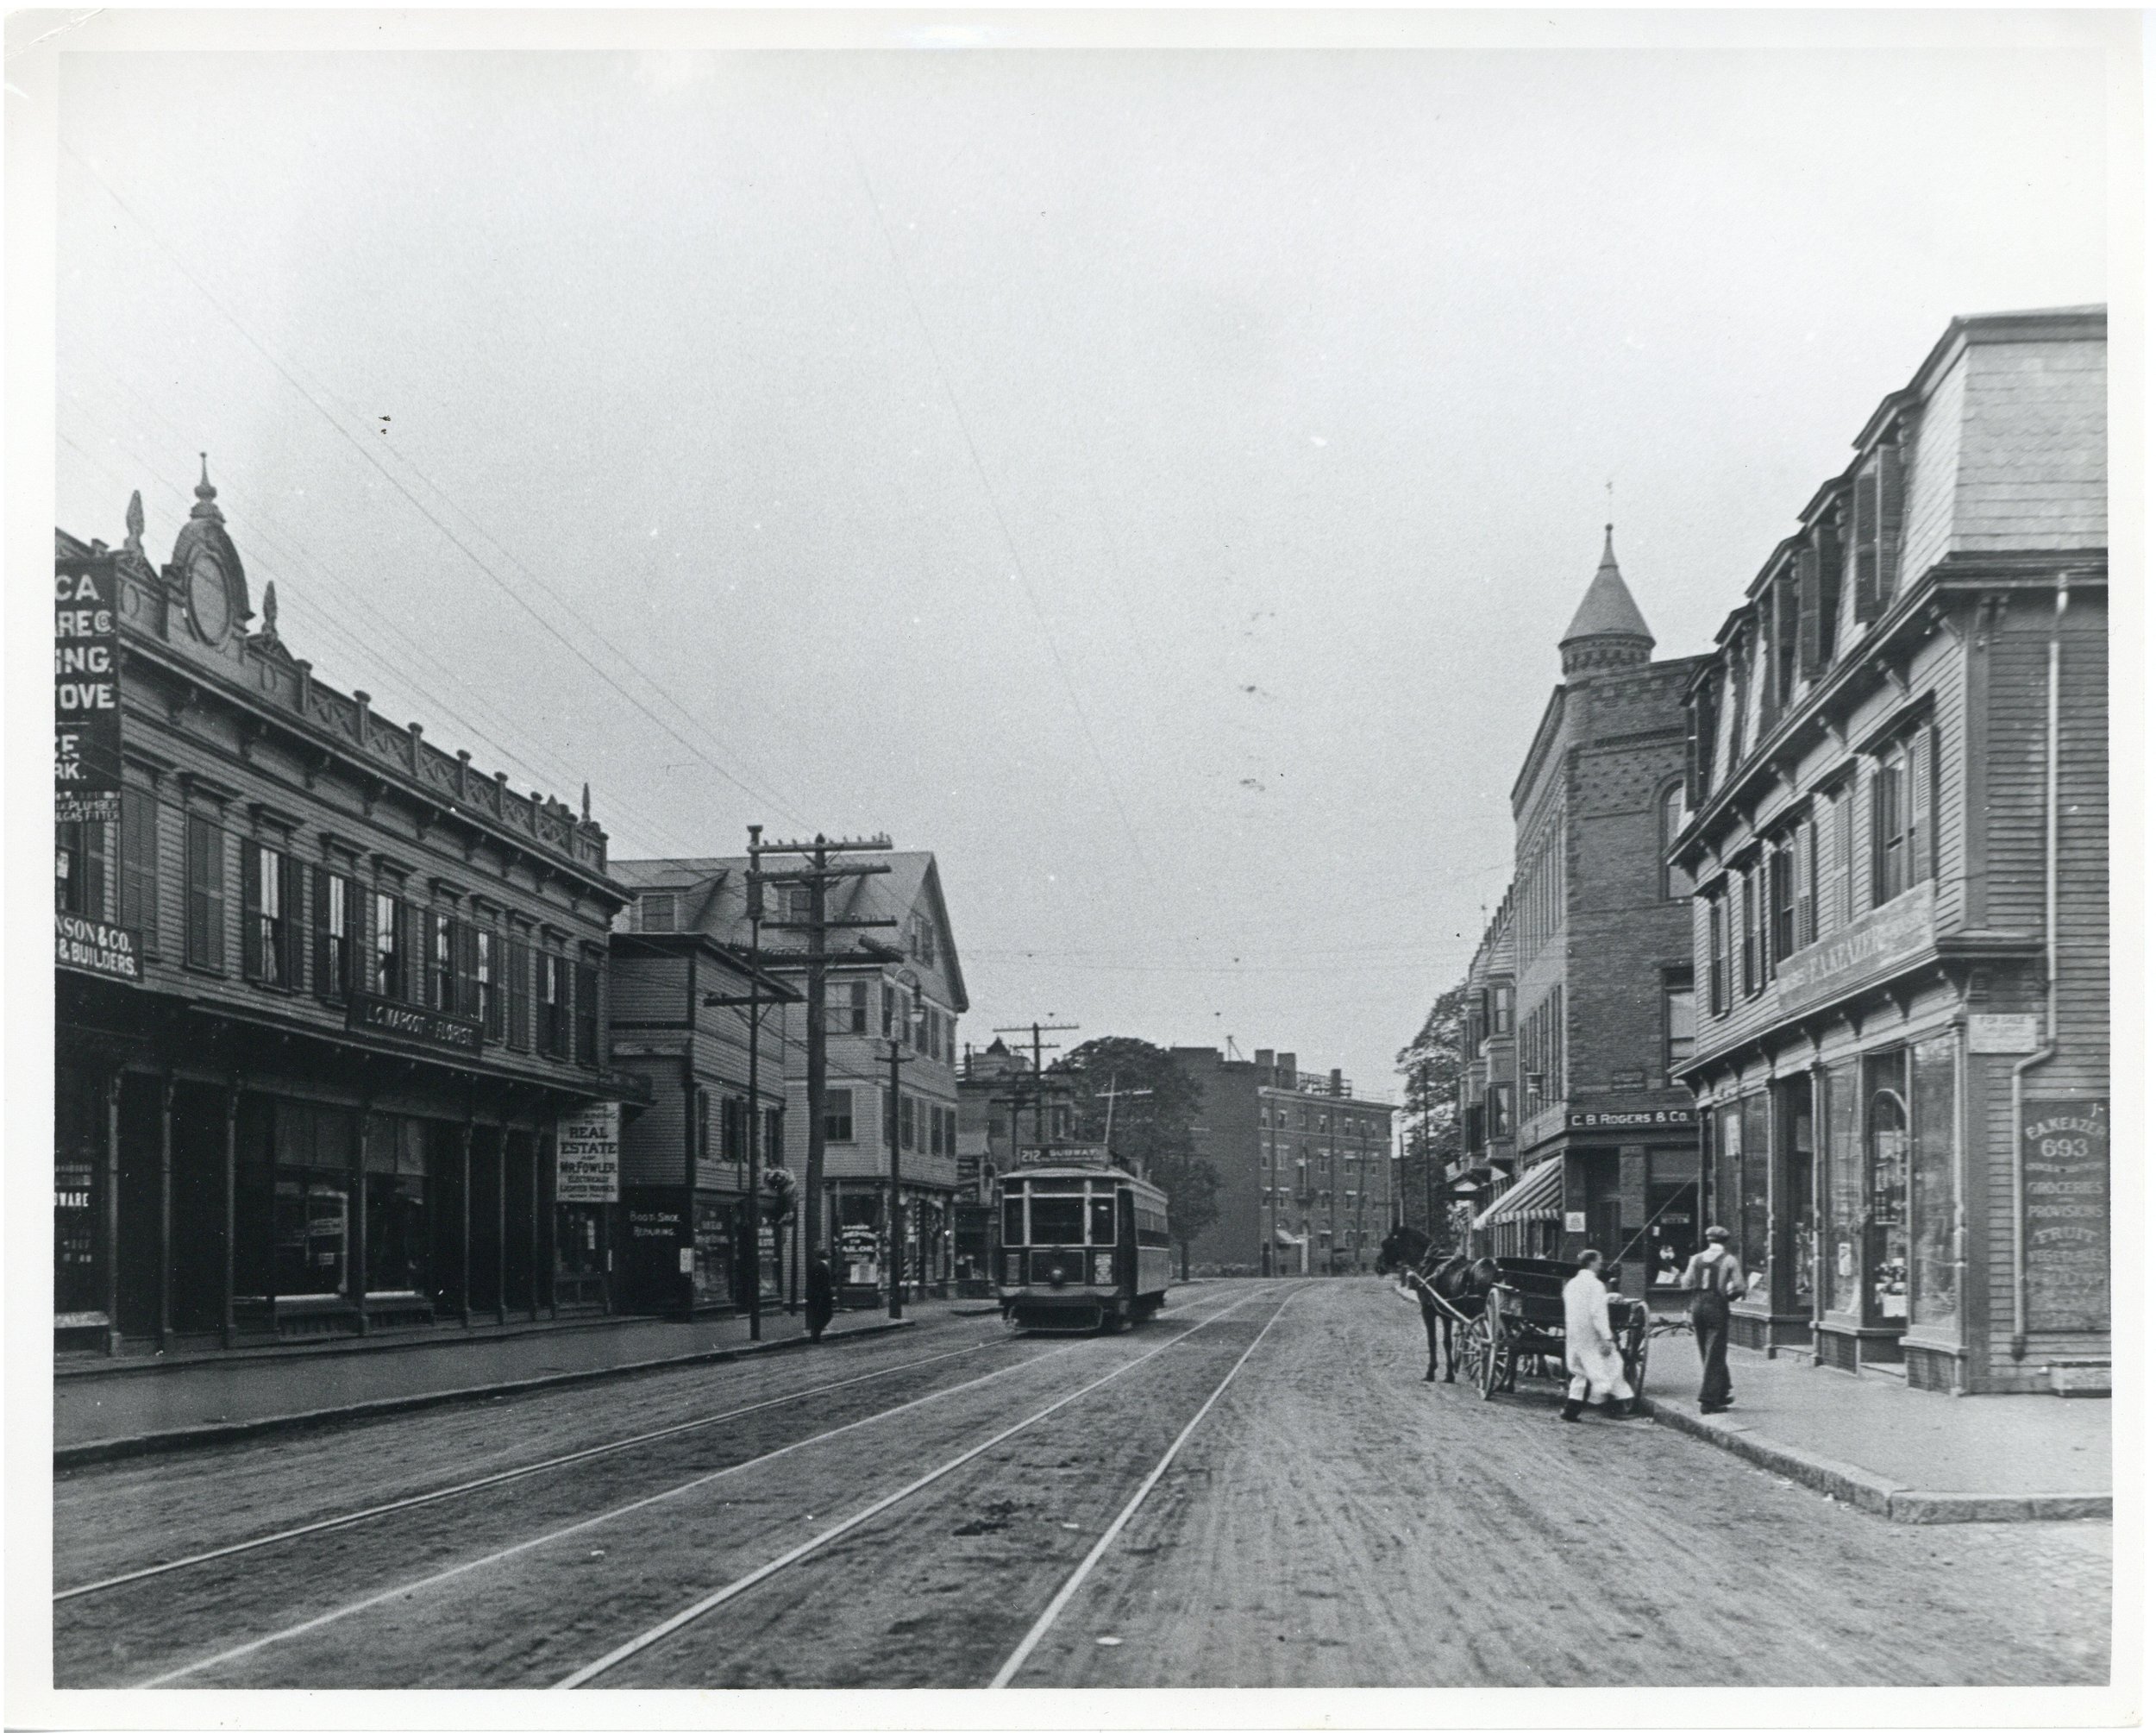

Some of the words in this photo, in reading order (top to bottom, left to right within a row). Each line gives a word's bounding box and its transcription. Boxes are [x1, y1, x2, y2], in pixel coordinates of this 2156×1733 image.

[54, 610, 93, 637] RE
[54, 683, 116, 709] OVE
[1600, 1113, 1651, 1124] ROGERS
[1656, 1111, 1666, 1122] &
[569, 1127, 609, 1139] REAL
[560, 1142, 619, 1154] ESTATE
[2040, 1139, 2089, 1157] 693
[2027, 1180, 2104, 1195] GROCERIES
[2027, 1204, 2104, 1218] PROVISIONS
[2034, 1226, 2100, 1245] FRUIT
